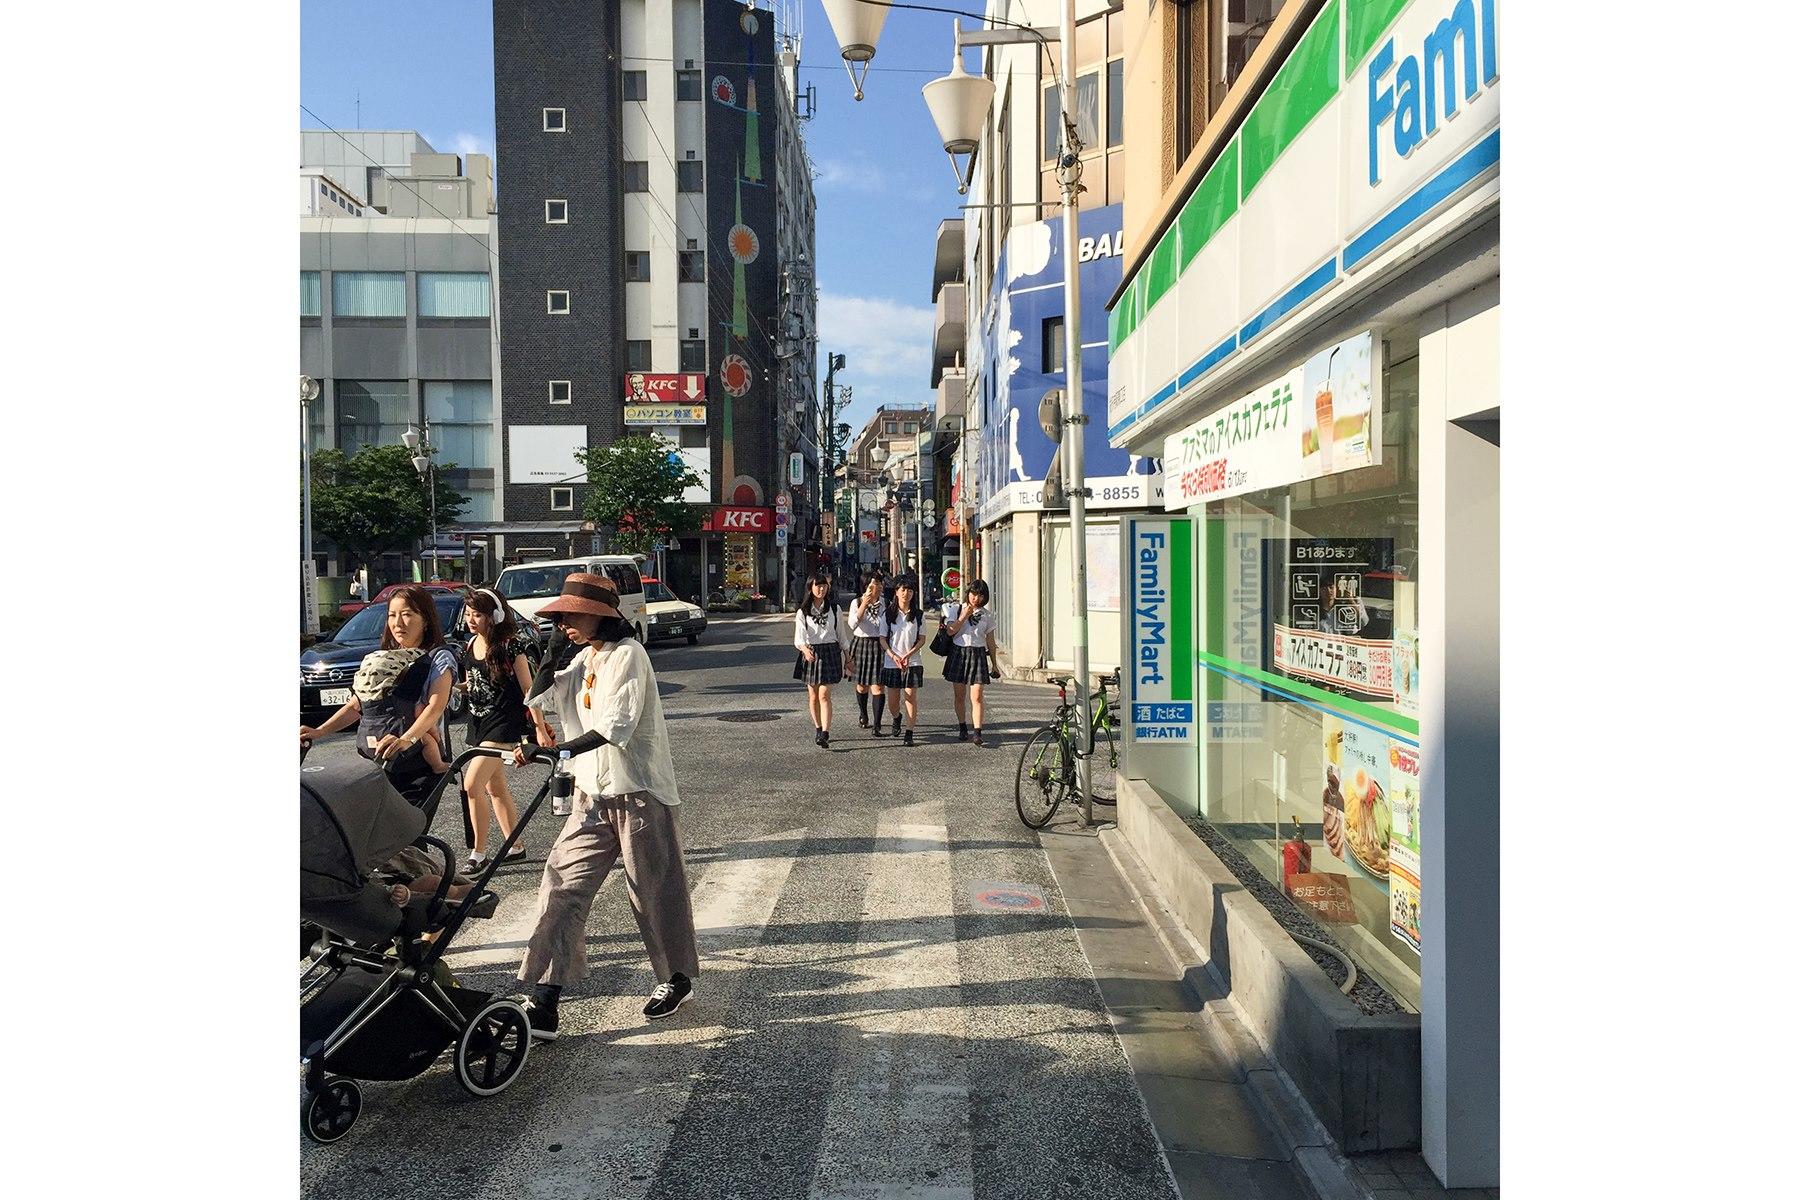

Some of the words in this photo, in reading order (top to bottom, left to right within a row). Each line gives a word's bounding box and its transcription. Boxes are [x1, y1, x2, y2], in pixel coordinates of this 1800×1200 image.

[1369, 0, 1499, 187] Fami
[1079, 230, 1123, 263] BAL
[647, 380, 678, 390] KFC
[1182, 382, 1293, 465] ファミマのアイスカフェラテ
[723, 511, 764, 527] KFC
[1296, 546, 1359, 558] B1あります
[1136, 532, 1166, 685] FamilyMart
[1137, 705, 1151, 721] 酒
[1156, 706, 1185, 720] たばこ
[1136, 726, 1187, 738] 銀行ATM
